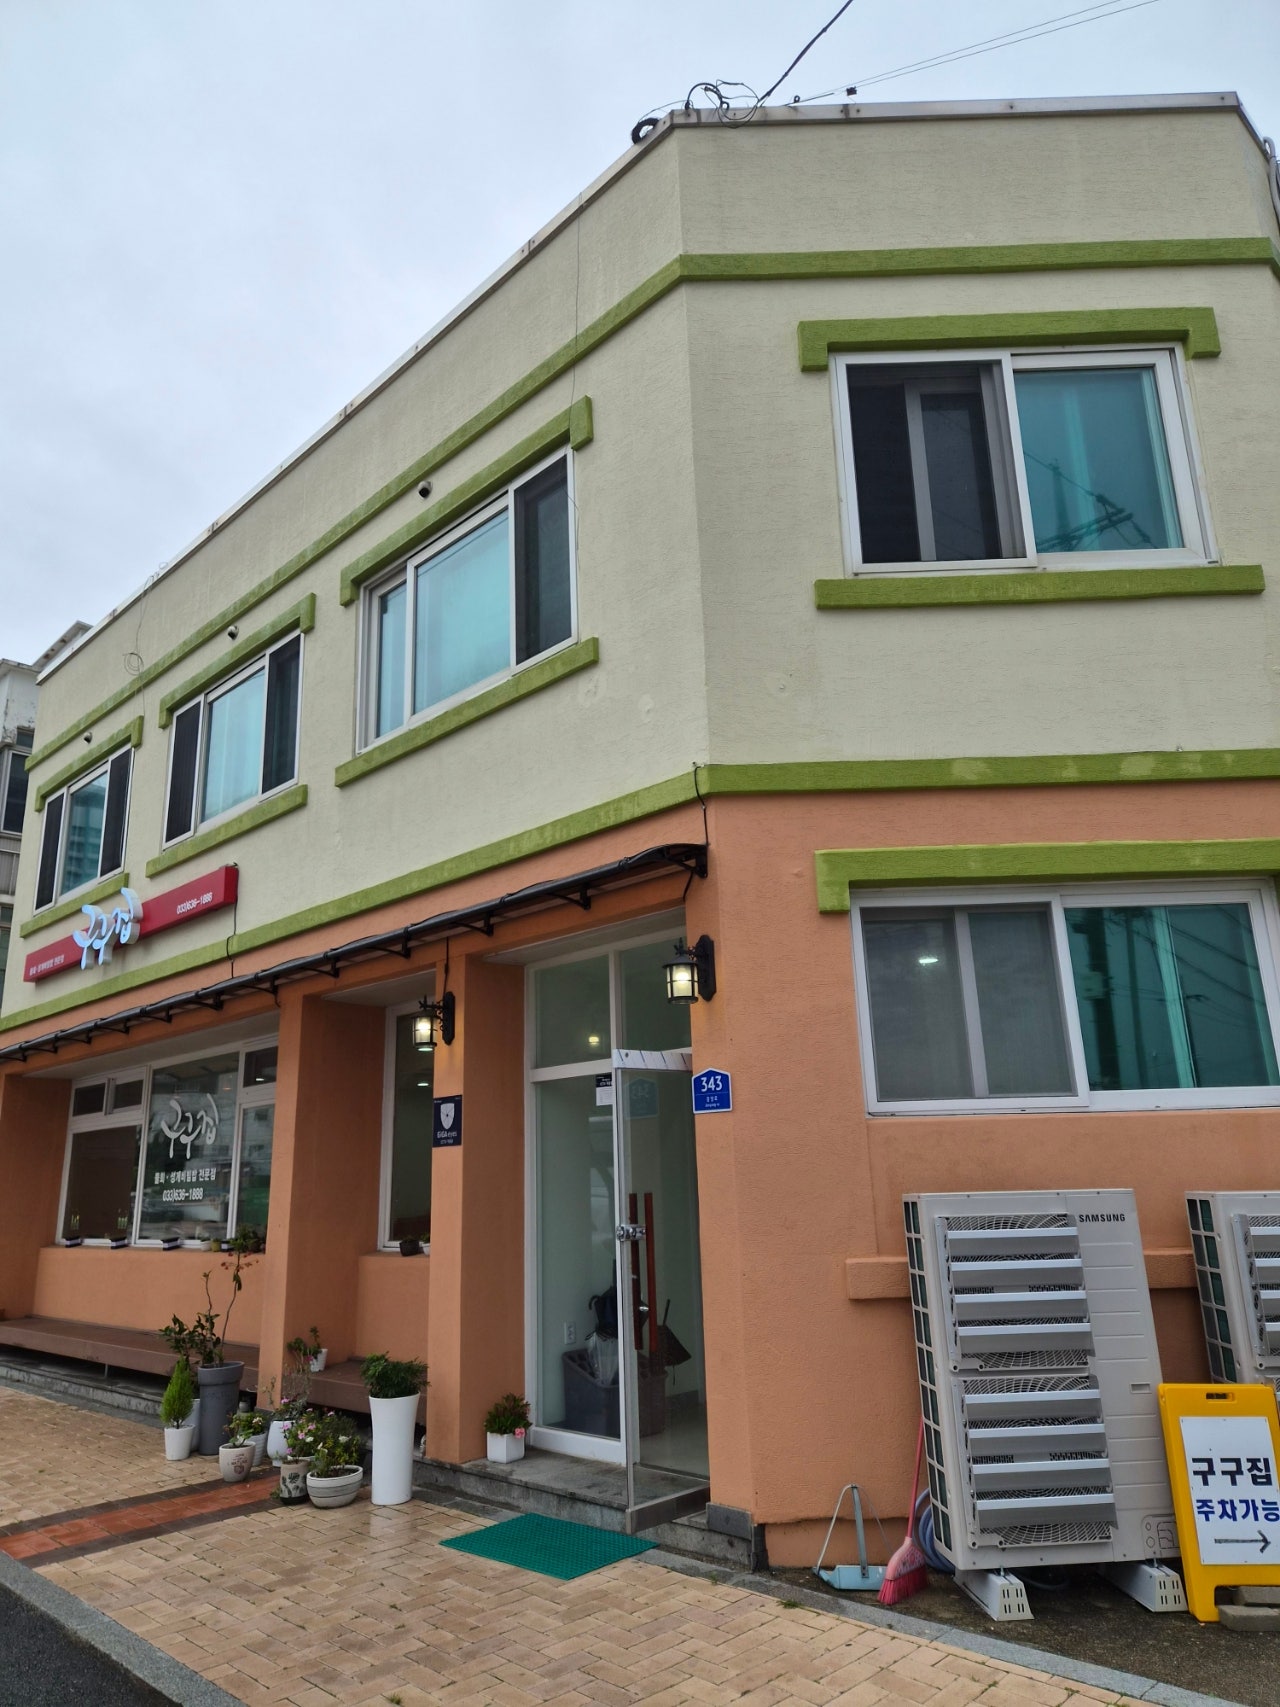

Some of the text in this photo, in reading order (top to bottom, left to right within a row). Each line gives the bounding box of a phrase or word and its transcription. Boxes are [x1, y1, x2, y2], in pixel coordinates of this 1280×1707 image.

[72, 887, 141, 970] 구구집
[700, 1075, 723, 1092] 343
[161, 1093, 219, 1159] 구구집
[1079, 1213, 1126, 1223] SAMSUNG
[1192, 1457, 1272, 1487] 구구집
[1196, 1498, 1280, 1522] 주차가능
